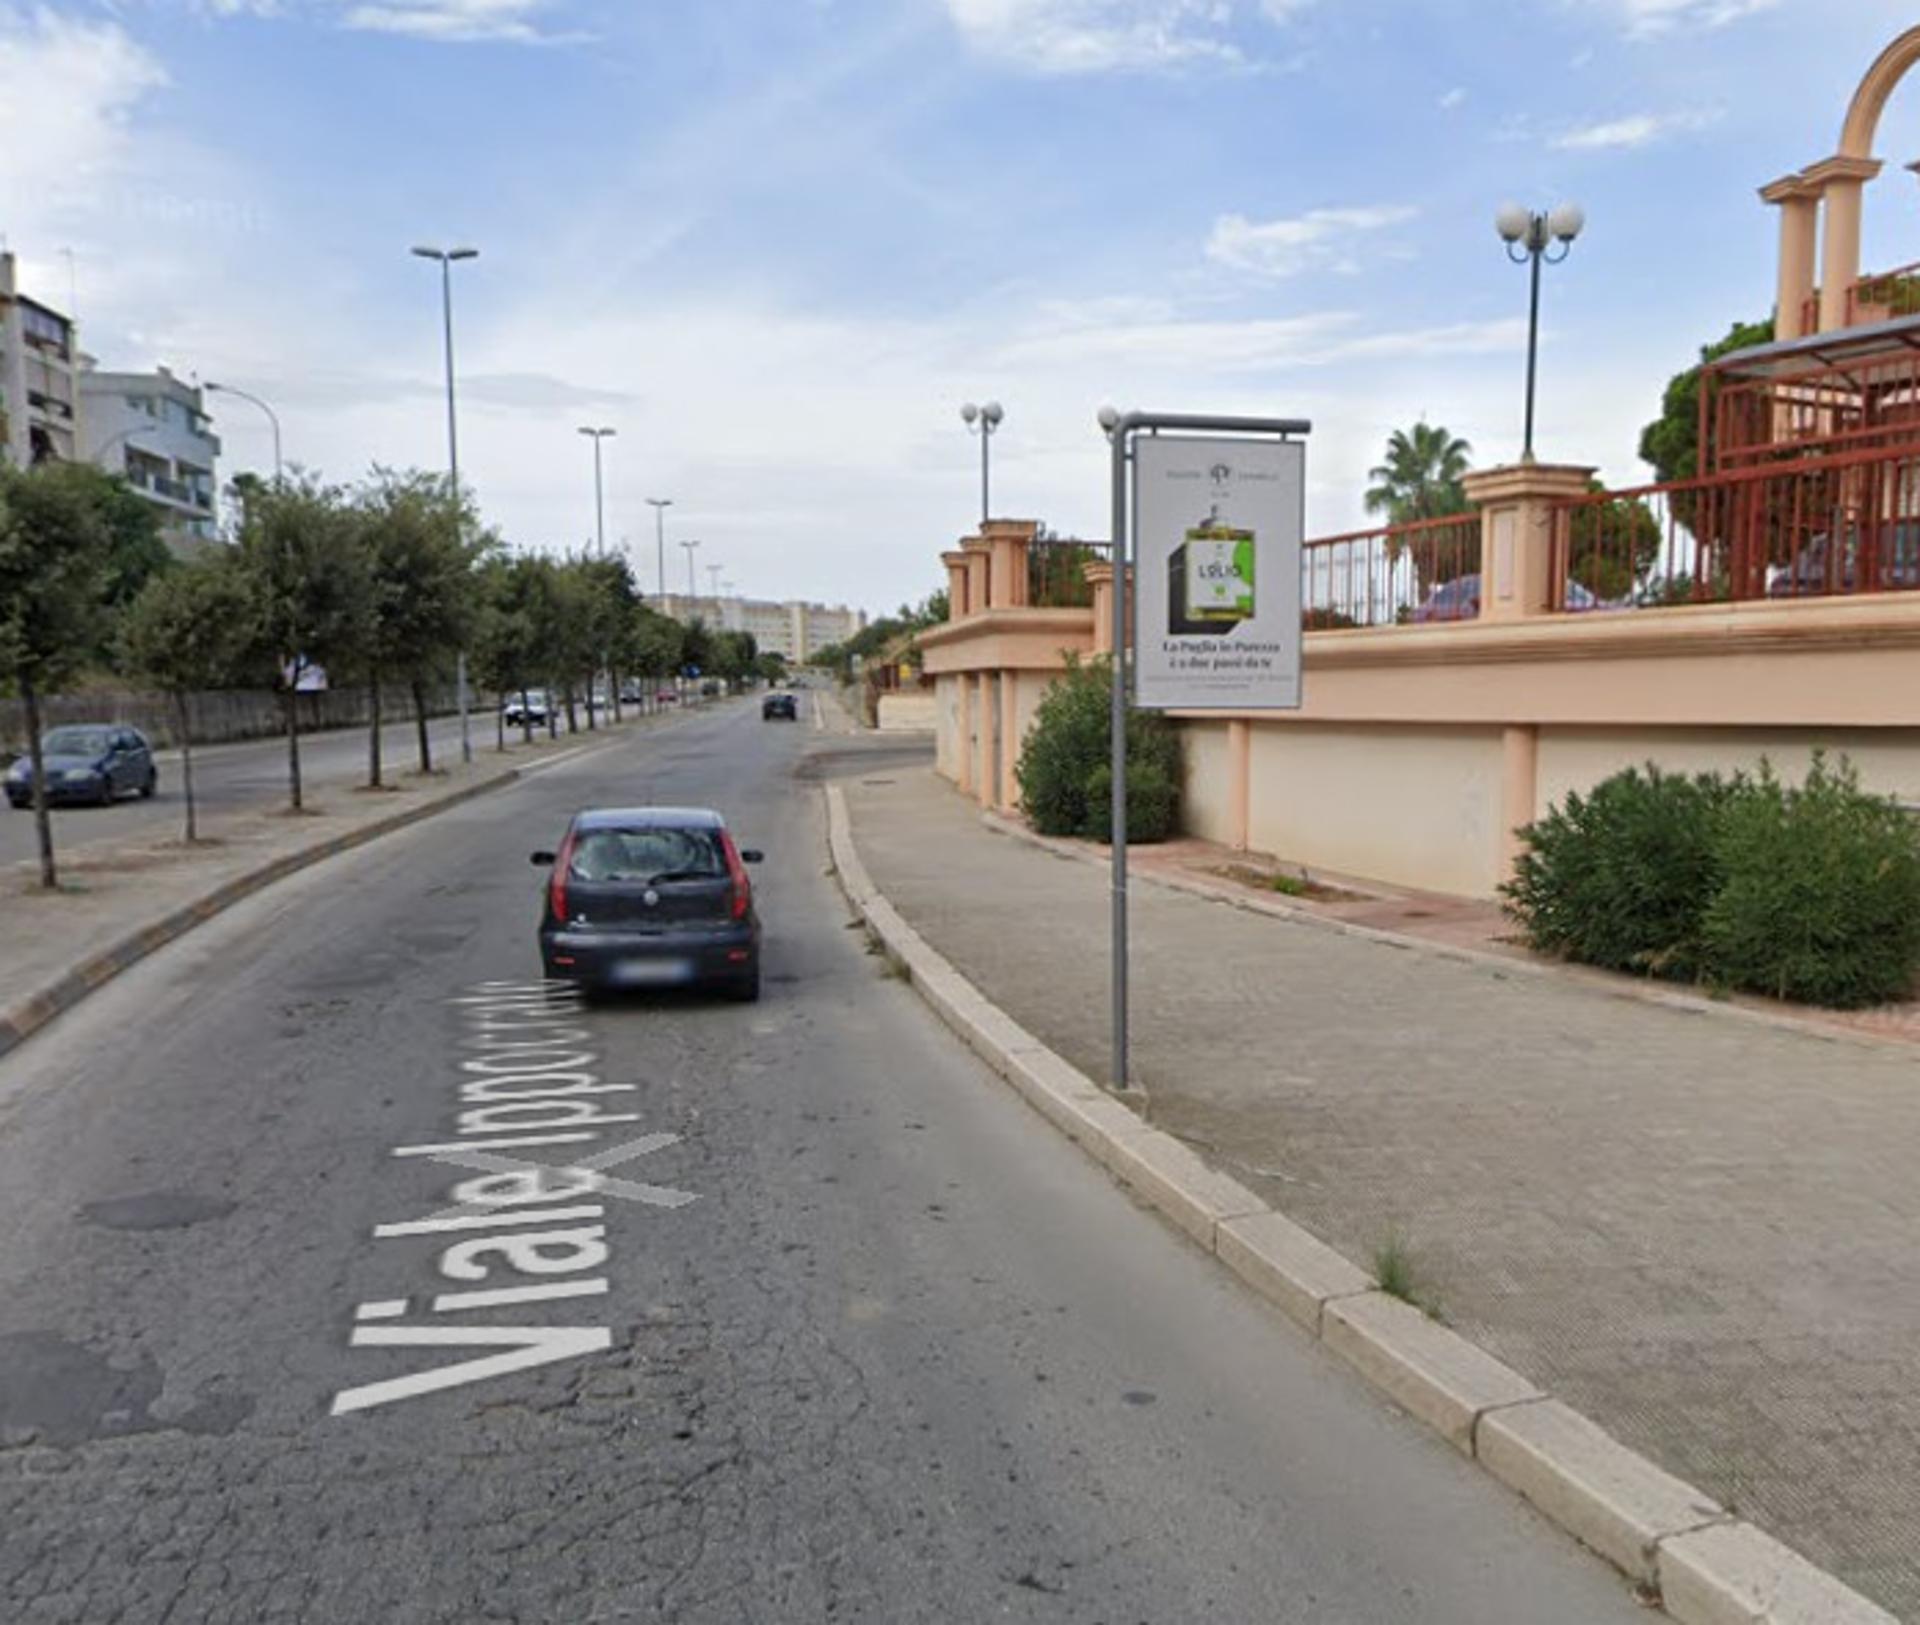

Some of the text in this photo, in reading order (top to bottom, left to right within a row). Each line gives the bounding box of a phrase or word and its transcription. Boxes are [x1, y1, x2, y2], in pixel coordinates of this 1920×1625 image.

[1163, 640, 1281, 654] La Puglia in Purezza
[1189, 656, 1209, 668] due
[1244, 656, 1259, 668] da
